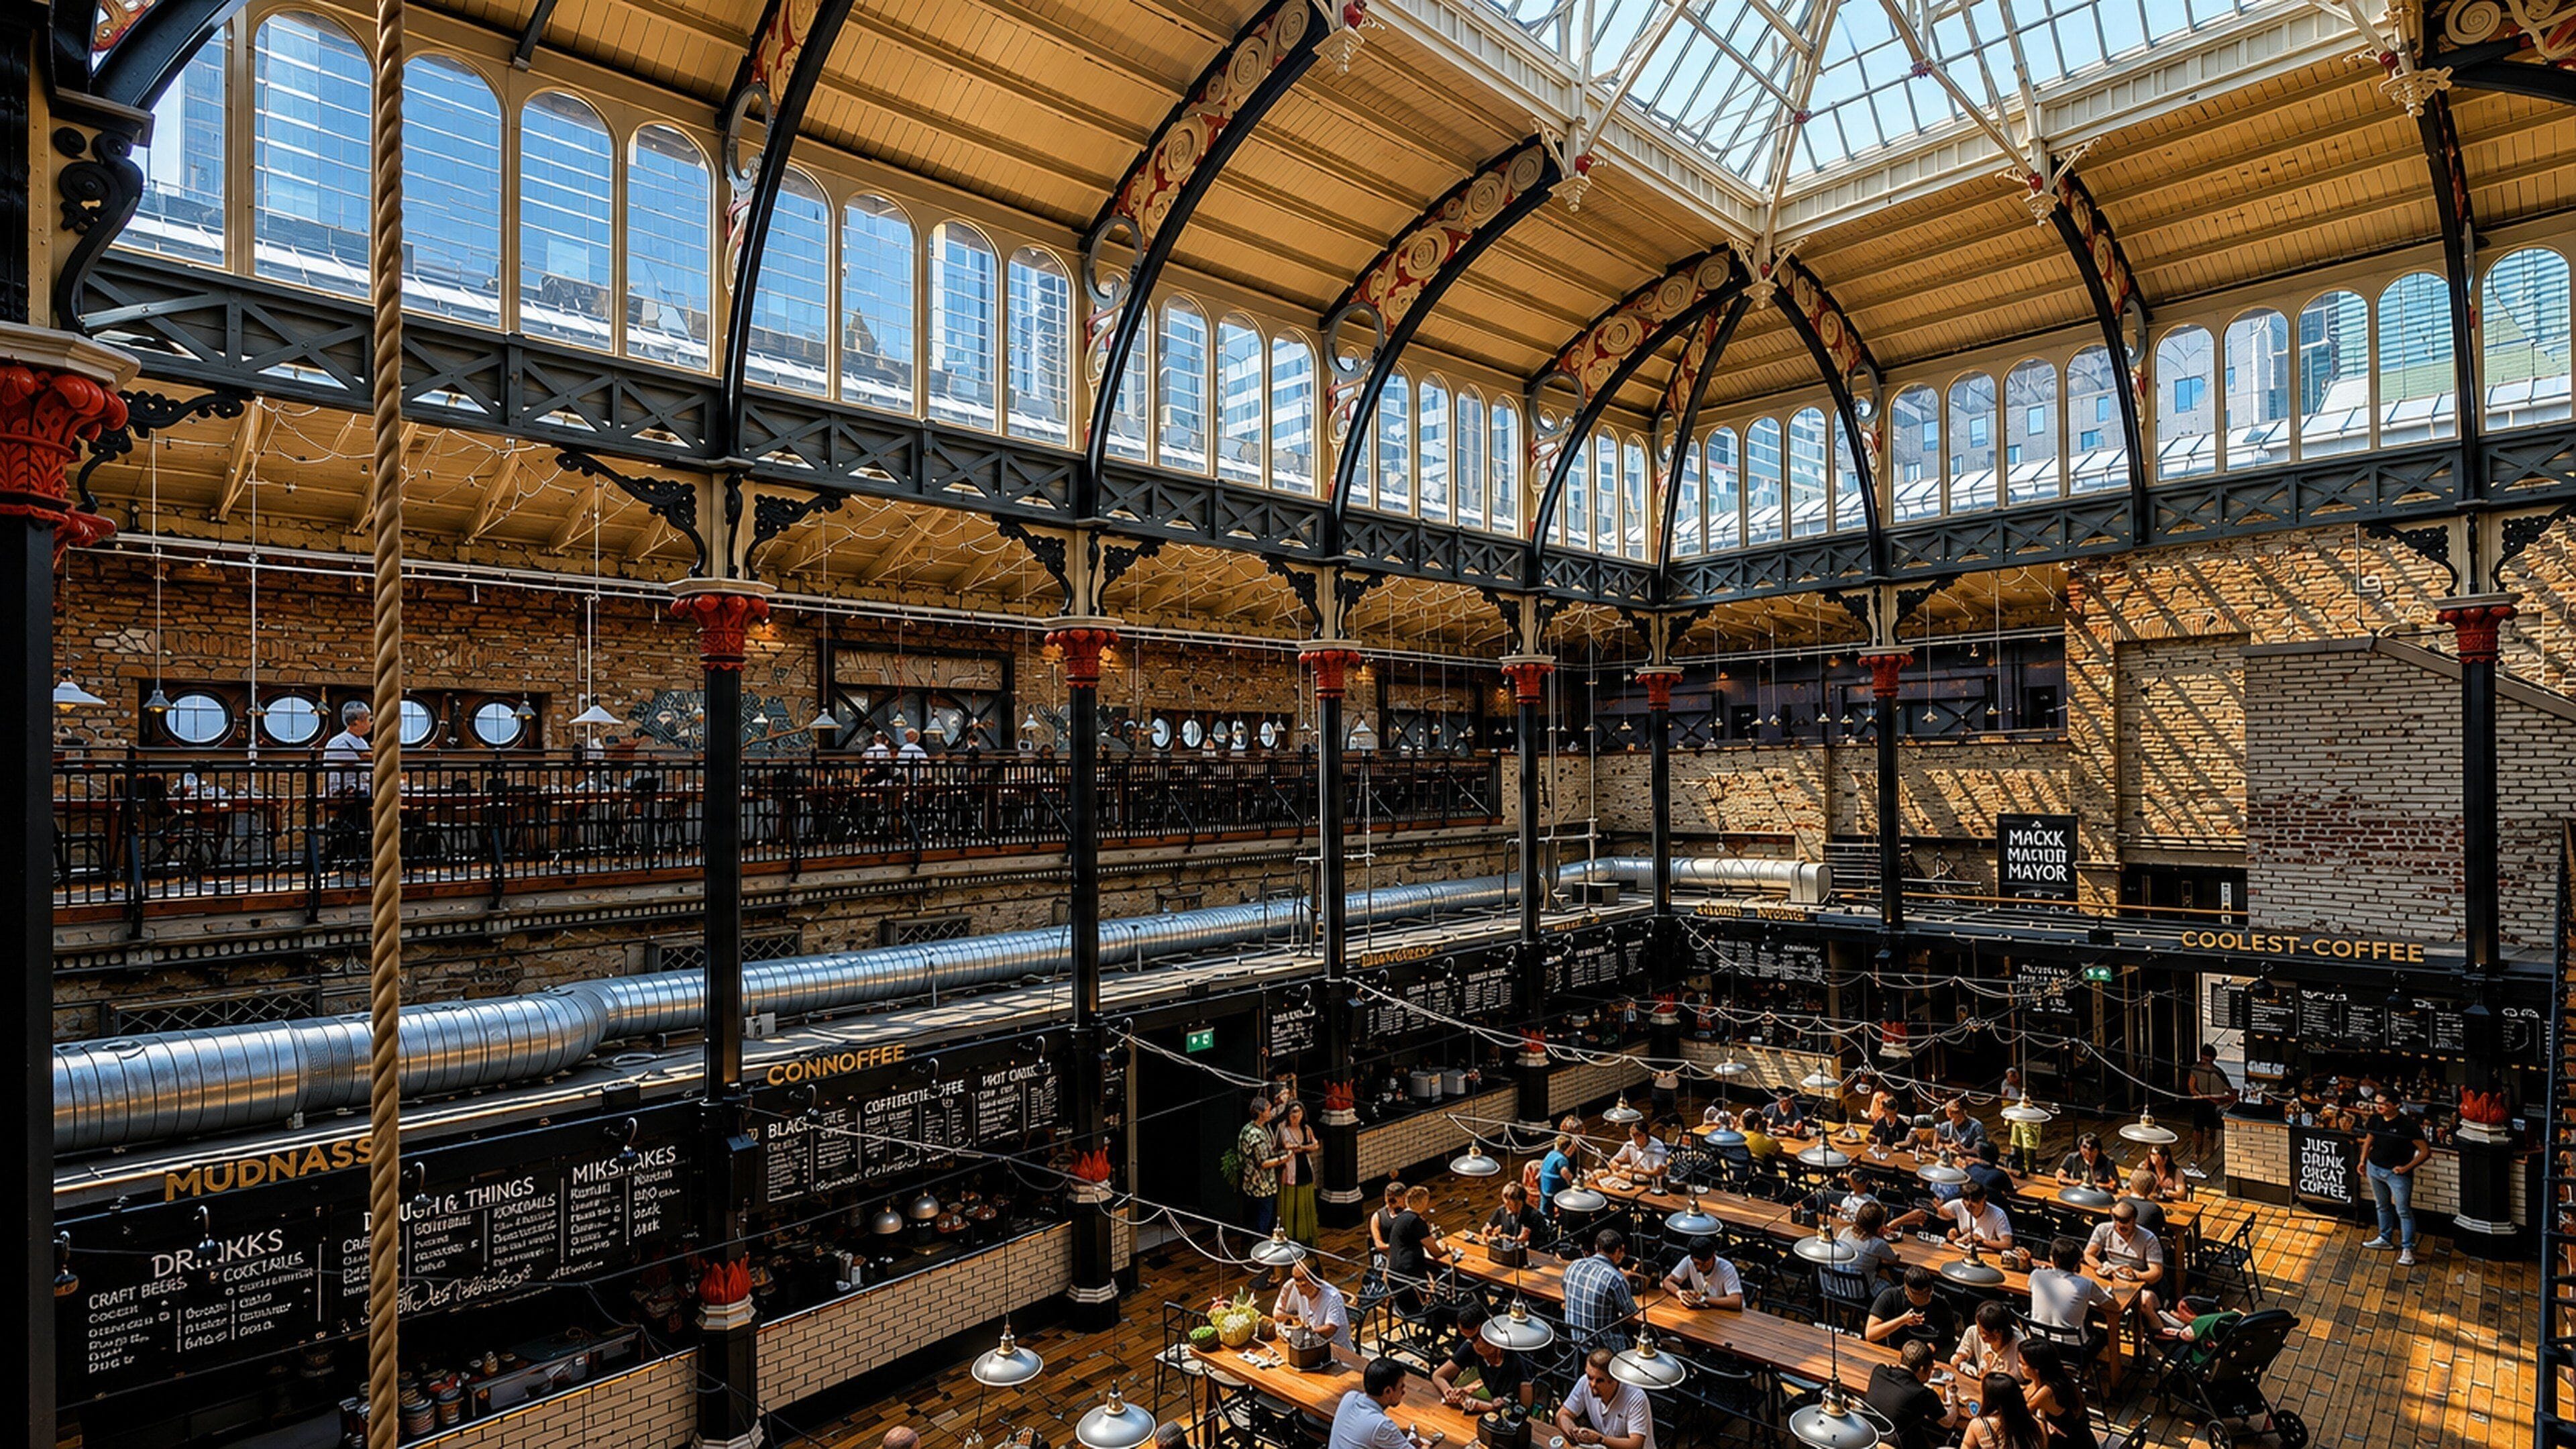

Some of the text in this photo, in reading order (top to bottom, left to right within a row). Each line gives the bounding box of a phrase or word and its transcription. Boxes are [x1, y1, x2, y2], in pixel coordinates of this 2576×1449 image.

[2008, 863, 2068, 882] MAYOR
[766, 1043, 907, 1087] CONNOFFEE
[2301, 1138, 2338, 1155] JUST
[572, 1145, 676, 1185] MIKSAKES
[464, 1176, 535, 1208] THINGS
[151, 1228, 283, 1278] DRKKS
[89, 1285, 137, 1309] CRAFT
